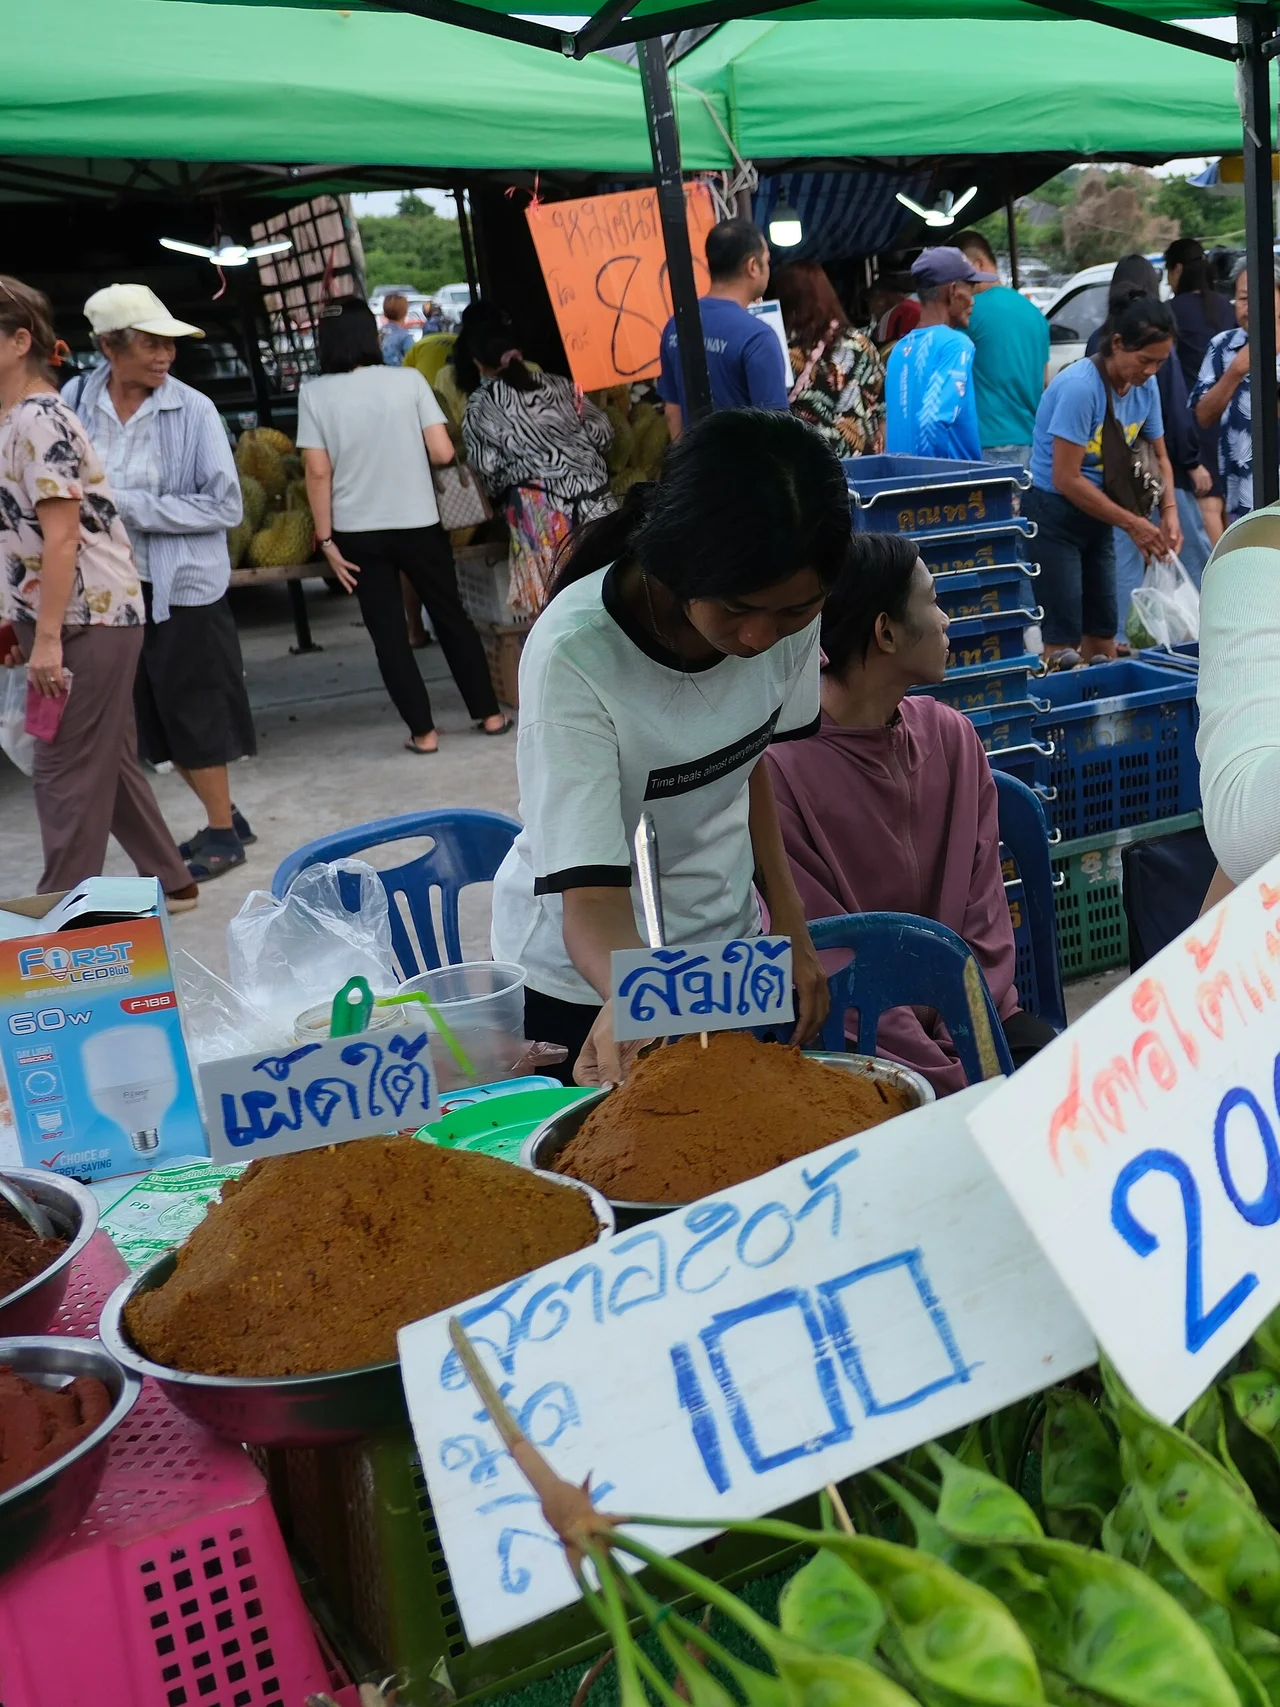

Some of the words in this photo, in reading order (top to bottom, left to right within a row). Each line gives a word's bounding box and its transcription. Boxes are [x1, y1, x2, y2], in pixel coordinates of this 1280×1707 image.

[897, 489, 987, 532] คุณทวี
[651, 776, 675, 790] Time
[677, 769, 702, 784] heals
[703, 757, 729, 777] almost
[70, 968, 110, 983] LED
[110, 965, 130, 978] Blub
[130, 995, 171, 1010] F-188
[59, 1148, 98, 1166] CHOICE
[98, 1148, 111, 1159] OF
[668, 1240, 985, 1495] 100
